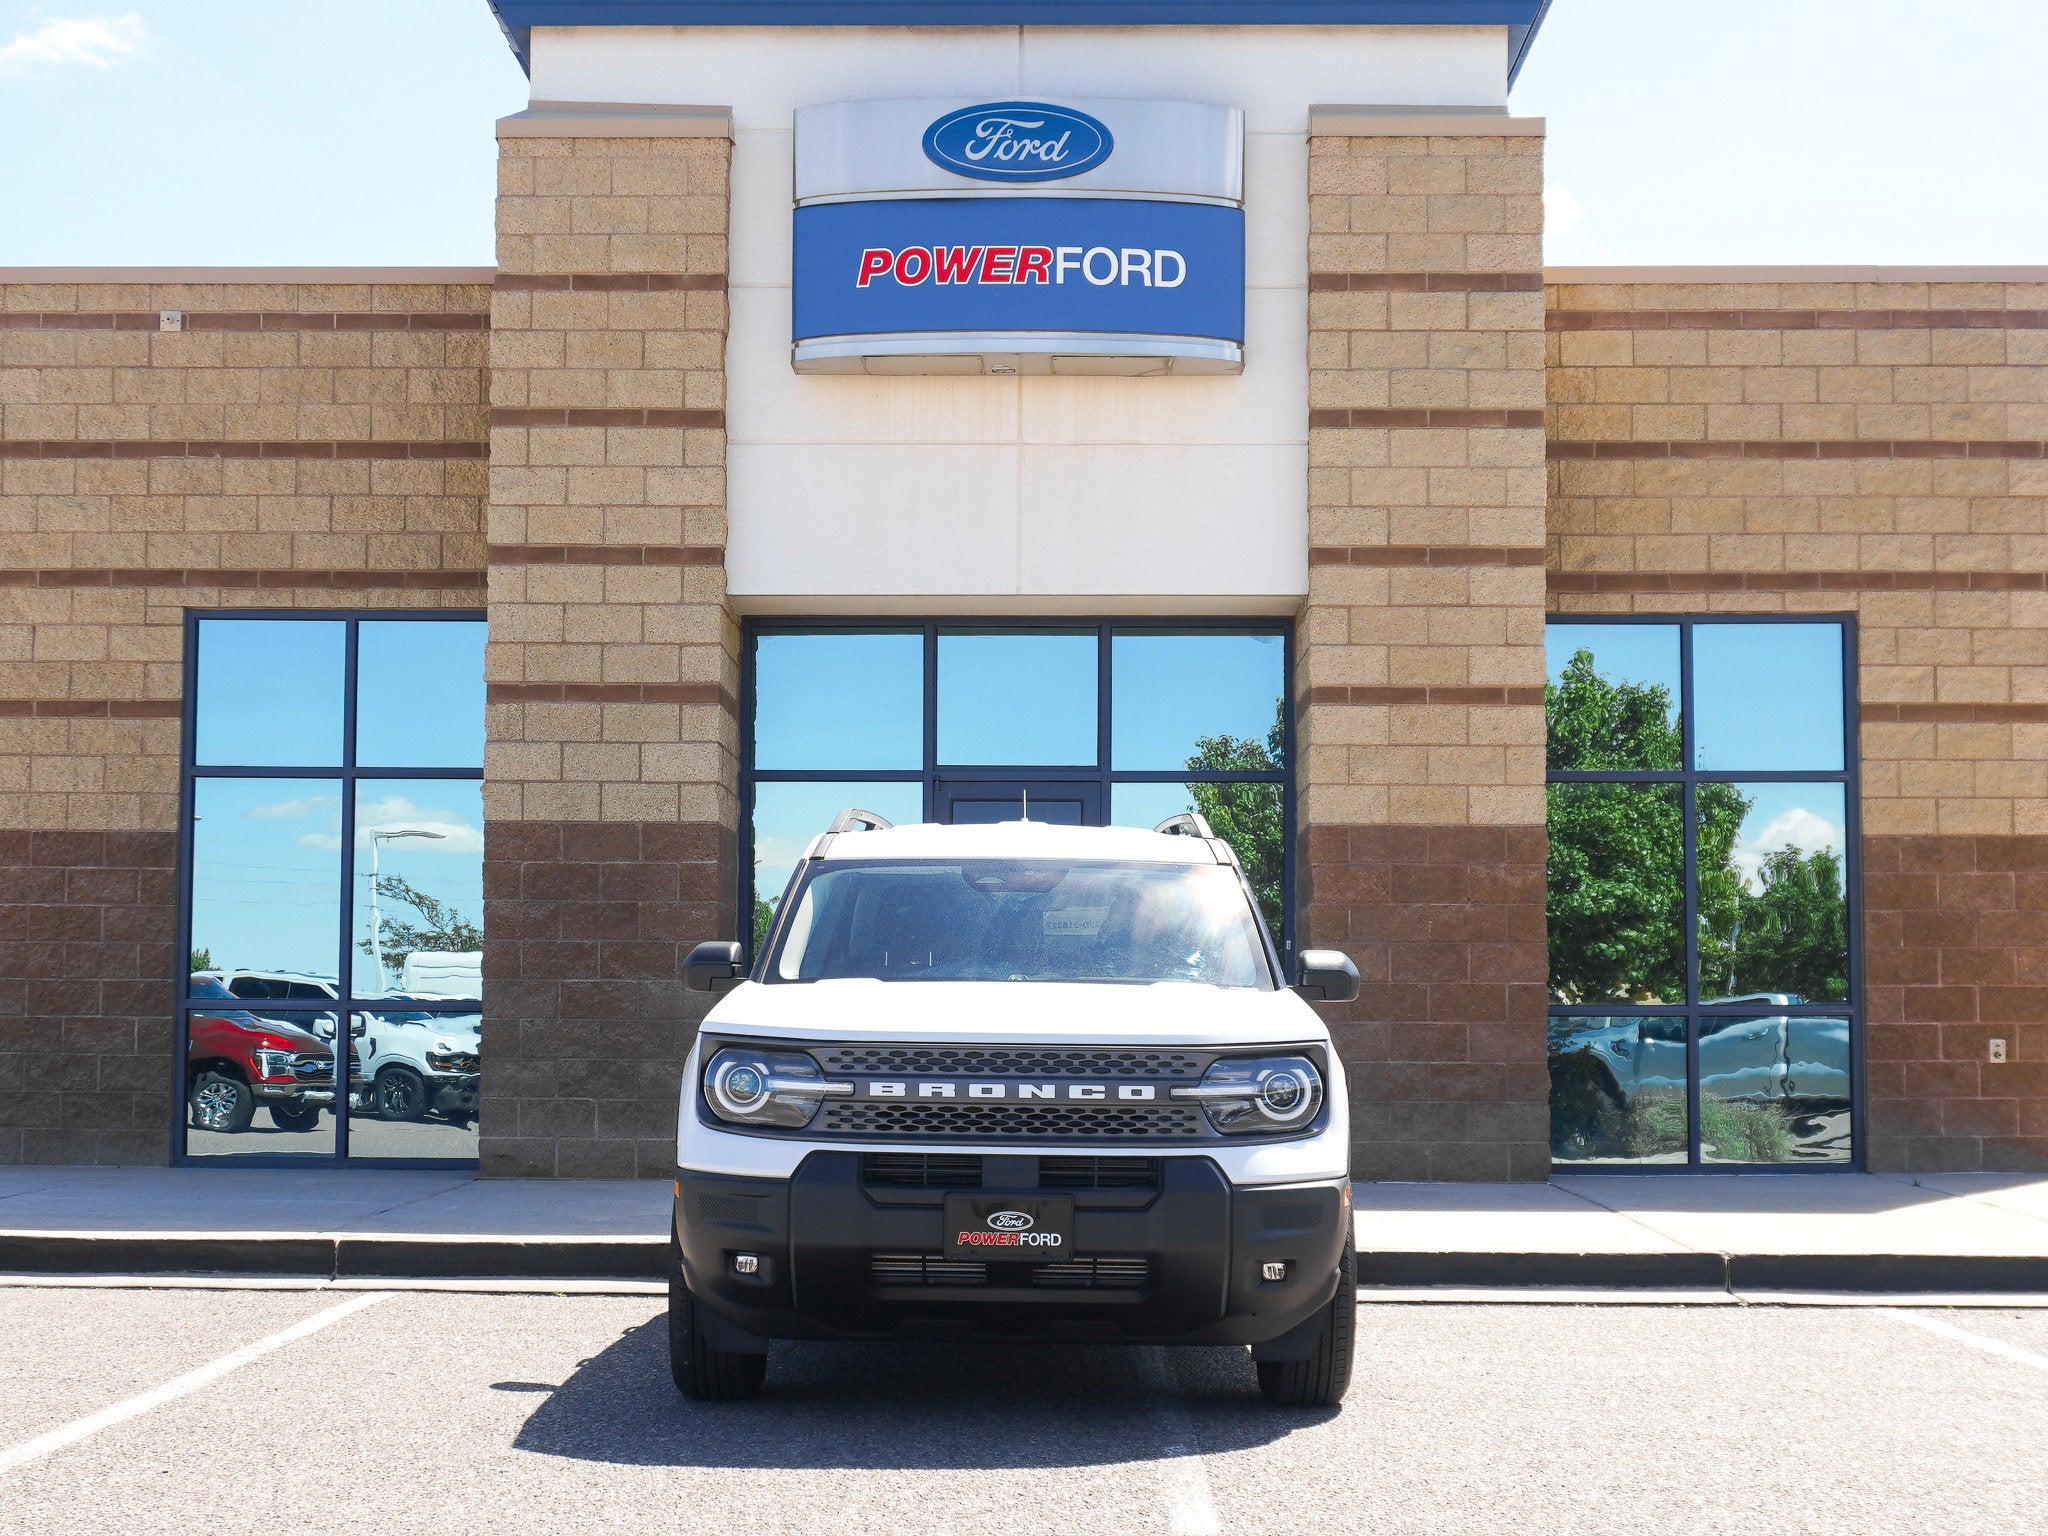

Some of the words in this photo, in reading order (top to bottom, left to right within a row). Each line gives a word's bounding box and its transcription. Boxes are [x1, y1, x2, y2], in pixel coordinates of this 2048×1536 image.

[965, 117, 1072, 163] Ford
[856, 246, 1187, 288] POWERFORD
[869, 1082, 1155, 1100] BRONCO
[996, 1214, 1025, 1227] Ford
